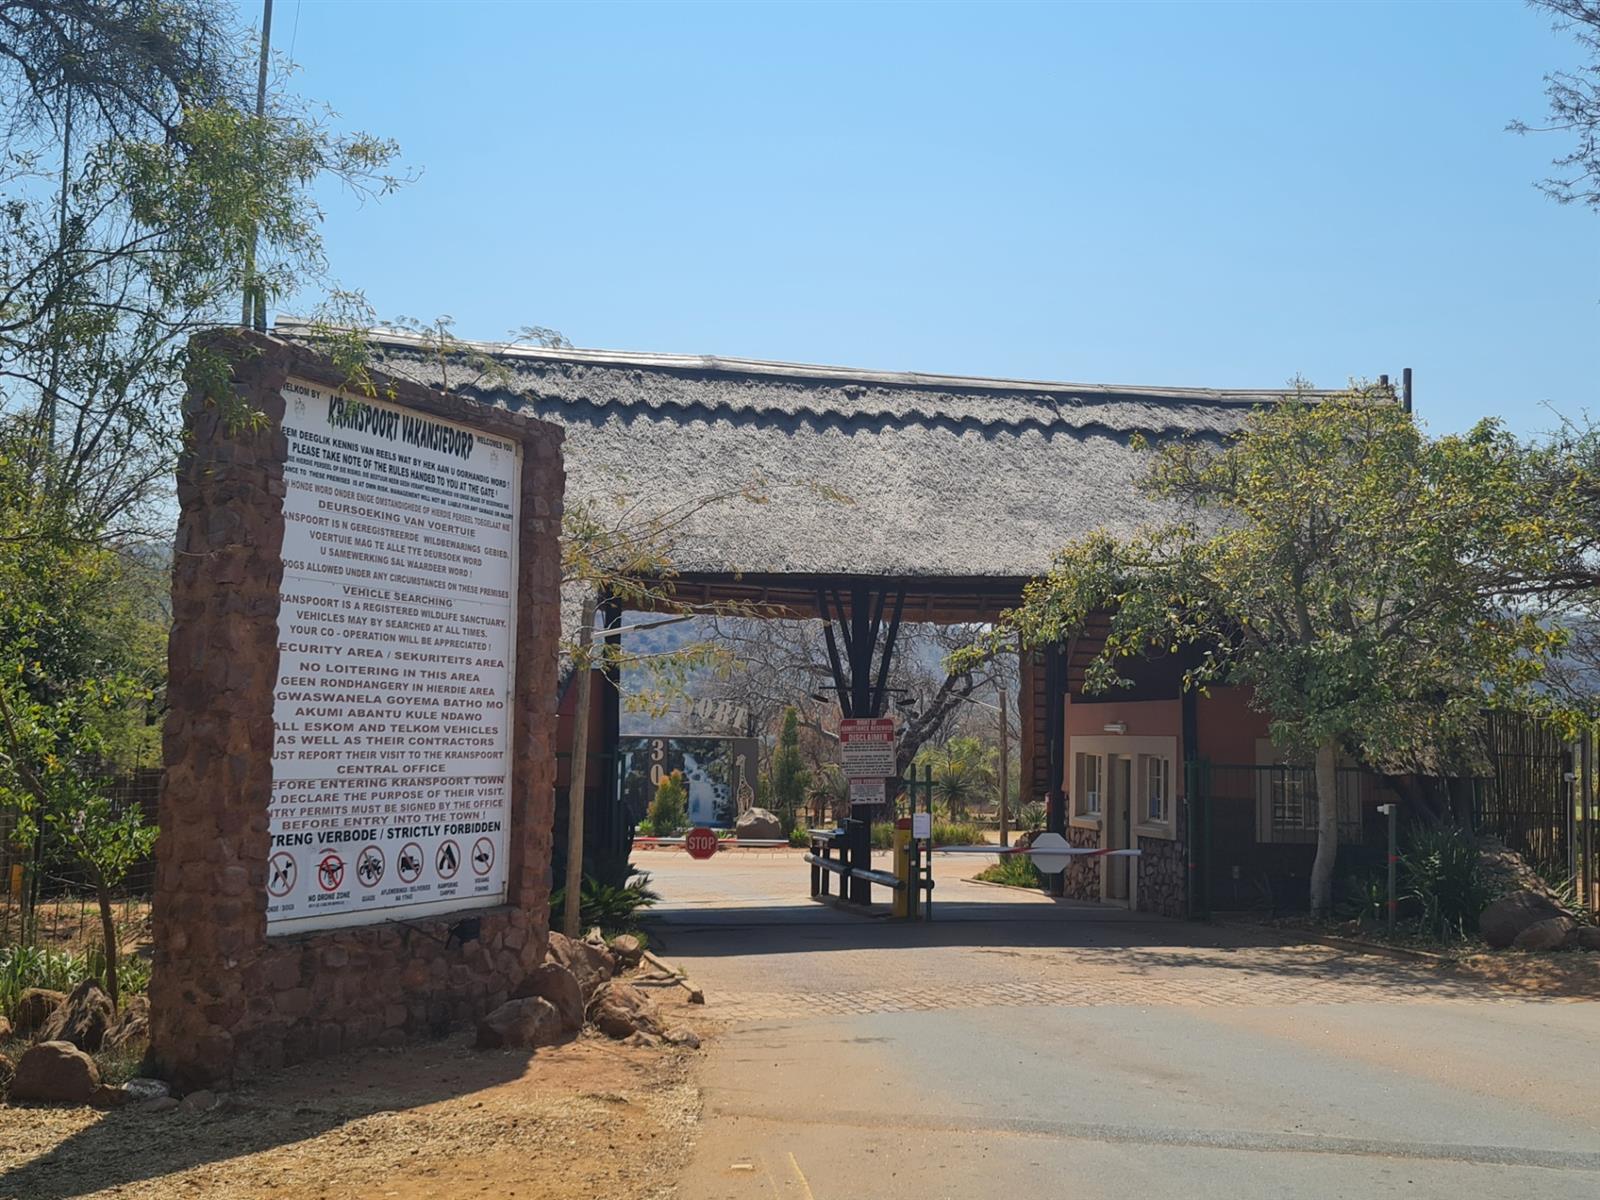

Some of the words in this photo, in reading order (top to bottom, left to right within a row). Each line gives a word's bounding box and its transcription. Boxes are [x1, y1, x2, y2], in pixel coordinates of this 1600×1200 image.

[312, 389, 320, 399] BY
[327, 394, 400, 442] KRANSPOORT
[402, 414, 474, 460] VAKANSIEDORP
[282, 426, 297, 436] EEM
[300, 430, 330, 446] DEEGLIK
[332, 438, 358, 452] KENNIS
[360, 446, 374, 456] VAN
[376, 449, 396, 460] REELS
[412, 458, 422, 468] BY
[292, 442, 320, 458] PLEASE
[322, 449, 340, 462] TAKE
[342, 454, 360, 468] NOTE
[363, 458, 372, 469] OF
[374, 460, 387, 472] THE
[388, 464, 409, 478] RULES
[410, 468, 436, 484] HANDED
[446, 478, 458, 490] YOU
[468, 483, 479, 495] THE
[480, 486, 494, 498] GATE
[310, 470, 325, 480] THESE
[291, 480, 313, 492] HONDE
[314, 484, 332, 496] WORD
[334, 488, 354, 500] ONDER
[356, 492, 374, 504] ENIGE
[318, 500, 400, 523] DEURSOEKING
[404, 515, 424, 528] VAN
[428, 520, 476, 538] VOERTUIE
[283, 511, 329, 527] ANSPOORT
[332, 519, 340, 529] IS
[350, 522, 419, 542] GEREGISTREERDE
[424, 535, 481, 554] WILDBEWARINGS
[310, 530, 352, 546] VOERTUIE
[354, 537, 372, 548] MAG
[374, 540, 384, 550] TE
[386, 543, 406, 554] ALLE
[408, 546, 422, 556] TYE
[424, 549, 461, 562] DEURSOEK
[463, 556, 482, 566] WORD
[328, 548, 389, 566] SAMEWERKING
[390, 558, 405, 568] SAL
[407, 560, 446, 574] WAARDEER
[448, 568, 468, 577] WORD
[282, 559, 304, 570] DOGS
[306, 562, 344, 576] ALLOWED
[346, 566, 371, 579] UNDER
[373, 572, 388, 581] ANY
[390, 574, 446, 590] CIRCUMSTANCES
[458, 584, 478, 594] THESE
[480, 587, 509, 598] PREMISES
[343, 586, 391, 600] VEHICLE
[394, 592, 453, 608] SEARCHING
[280, 593, 340, 608] RANSPOORT
[342, 600, 352, 610] IS
[362, 603, 419, 616] REGISTERED
[421, 610, 458, 622] WILDLIFE
[460, 614, 507, 628] SANCTUARY.
[296, 610, 345, 624] VEHICLES
[348, 616, 368, 626] MAY
[370, 618, 383, 628] BY
[386, 620, 430, 632] SEARCHED
[433, 624, 443, 633] AT
[446, 626, 460, 635] ALL
[462, 628, 488, 638] TIMES.
[290, 625, 318, 636] YOUR
[320, 628, 334, 637] CO
[342, 630, 396, 642] OPERATION
[398, 634, 418, 644] WILL
[421, 636, 432, 646] BE
[434, 638, 488, 651] APPRECIATED
[279, 642, 342, 656] ECURITY
[347, 648, 384, 658] AREA
[394, 651, 472, 666] SEKURITEITS
[475, 658, 504, 668] AREA
[300, 662, 320, 672] NO
[326, 664, 399, 678] LOITERING
[404, 669, 416, 678] IN
[420, 670, 447, 680] THIS
[450, 672, 480, 682] AREA
[281, 676, 316, 686] GEEN
[320, 678, 409, 692] RONDHANGERY
[412, 683, 424, 692] IN
[426, 684, 466, 694] HIERDIE
[469, 686, 496, 696] AREA
[276, 691, 382, 704] GWASWANELA
[386, 696, 440, 706] GOYEMA
[444, 698, 483, 708] BATHO
[486, 701, 504, 709] MO
[295, 707, 343, 716] AKUMI
[348, 708, 402, 719] ABANTU
[406, 710, 438, 720] KULE
[441, 712, 482, 721] NDAWO
[274, 722, 300, 732] ALL
[304, 722, 354, 732] ESKOM
[358, 724, 386, 732] AND
[390, 724, 440, 733] TELKOM
[443, 726, 499, 735] VEHICLES
[276, 736, 296, 745] AS
[301, 736, 340, 745] WELL
[344, 736, 362, 745] AS
[366, 736, 404, 745] THEIR
[408, 737, 494, 746] CONTRACTORS
[272, 750, 294, 760] UST
[298, 750, 342, 760] REPORT
[346, 750, 377, 760] THEIR
[380, 750, 406, 760] VISIT
[408, 750, 422, 760] TO
[424, 750, 444, 760] THE
[445, 751, 504, 760] KRANSPOORT
[336, 765, 398, 774] CENTRAL
[402, 764, 446, 773] OFFICE
[272, 780, 316, 790] EFORE
[320, 778, 388, 789] ENTERING
[392, 776, 470, 787] KRANSPOORT
[475, 776, 504, 784] TOWN
[281, 793, 339, 804] DECLARE
[344, 792, 366, 802] THE
[371, 790, 424, 800] PURPOSE
[427, 790, 440, 798] OF
[444, 788, 474, 798] THEIR
[478, 788, 504, 796] VISIT.
[270, 808, 296, 818] NTRY
[300, 806, 348, 816] PERMITS
[352, 804, 381, 814] MUST
[384, 804, 397, 812] BE
[400, 802, 436, 812] SIGNED
[438, 801, 450, 810] BY
[454, 800, 470, 809] THE
[474, 799, 504, 808] OFFICE
[282, 818, 339, 830] BEFORE
[344, 816, 388, 826] ENTRY
[394, 814, 421, 824] INTO
[425, 813, 446, 822] THE
[450, 812, 480, 820] TOWN
[272, 832, 313, 846] TRENG
[318, 829, 377, 844] VERBODE
[387, 825, 441, 839] STRICTLY
[444, 821, 501, 836] FORBIDDEN
[688, 836, 714, 850] STOP
